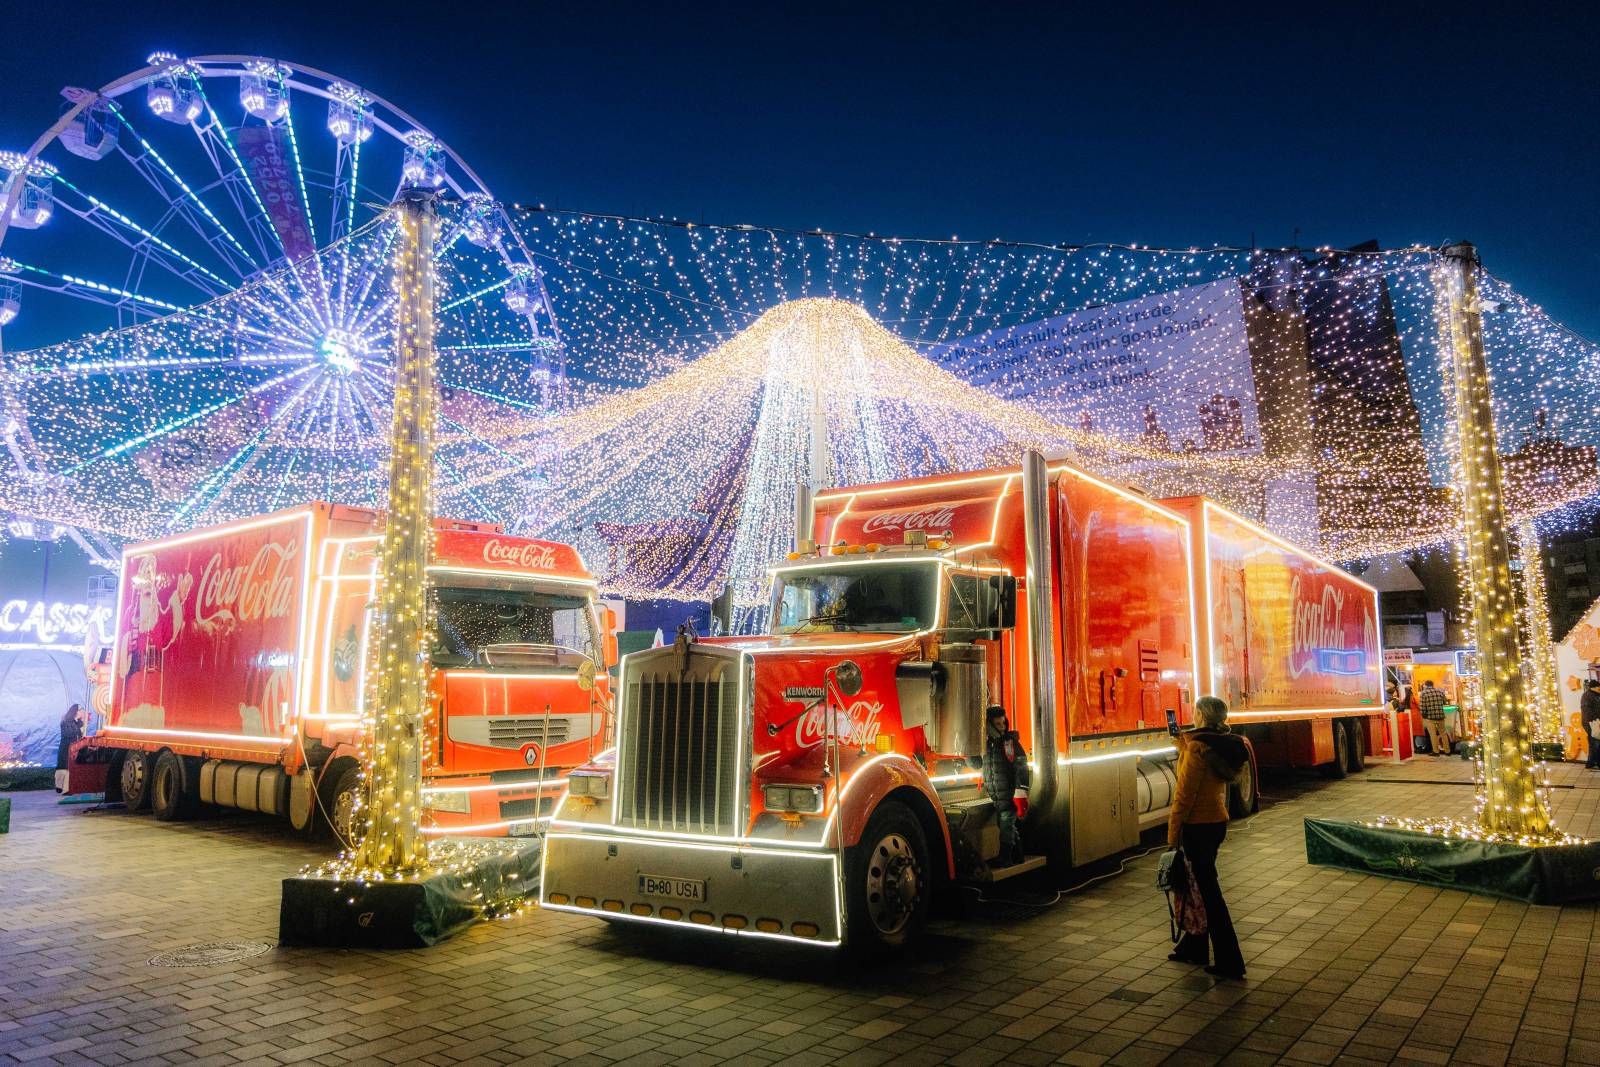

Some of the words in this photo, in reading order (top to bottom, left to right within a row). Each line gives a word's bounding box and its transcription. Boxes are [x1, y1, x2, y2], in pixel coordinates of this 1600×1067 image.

[862, 503, 962, 534] Coca-Cola
[483, 538, 557, 570] Coca-Cola
[195, 538, 303, 625] Coca-Cola
[786, 686, 825, 697] KENWORTH
[676, 882, 699, 899] USA
